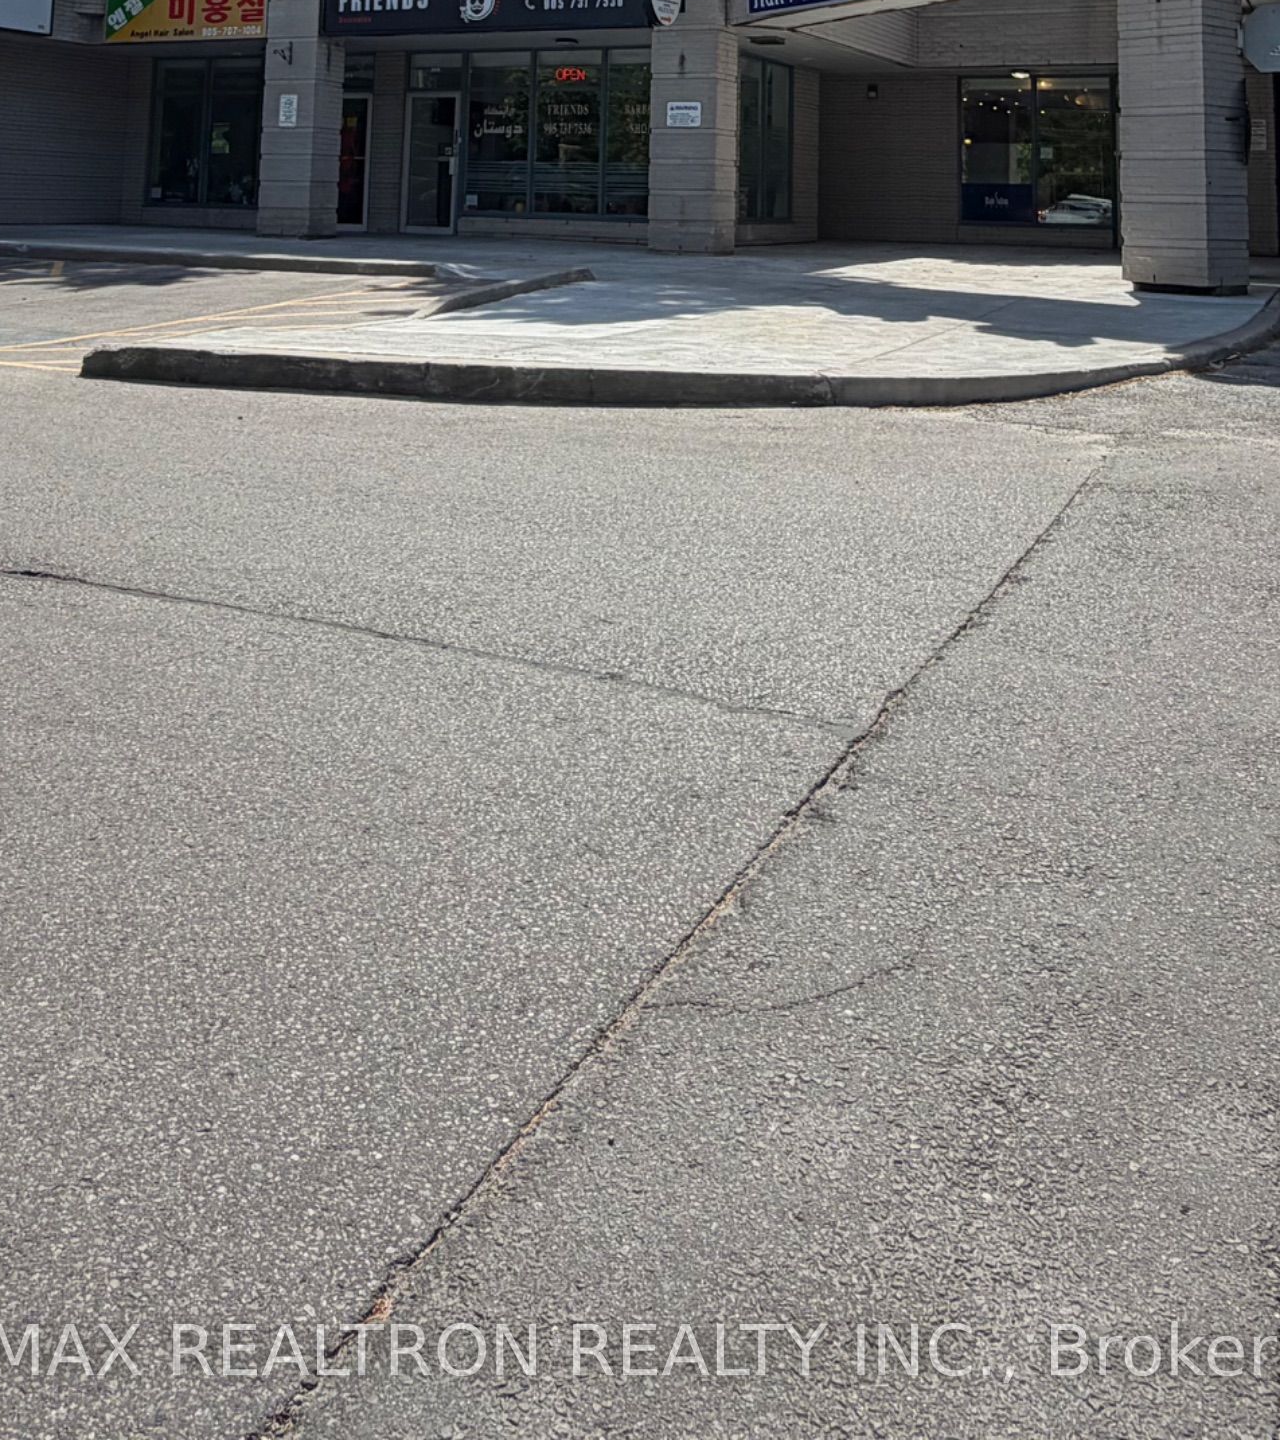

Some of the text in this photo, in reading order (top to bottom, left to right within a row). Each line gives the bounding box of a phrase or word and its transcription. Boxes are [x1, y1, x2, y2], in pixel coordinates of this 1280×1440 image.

[130, 29, 153, 38] Angel
[153, 29, 169, 37] Hair
[172, 28, 195, 36] Salon
[554, 67, 588, 82] OPEN
[547, 103, 590, 116] FRIENDS
